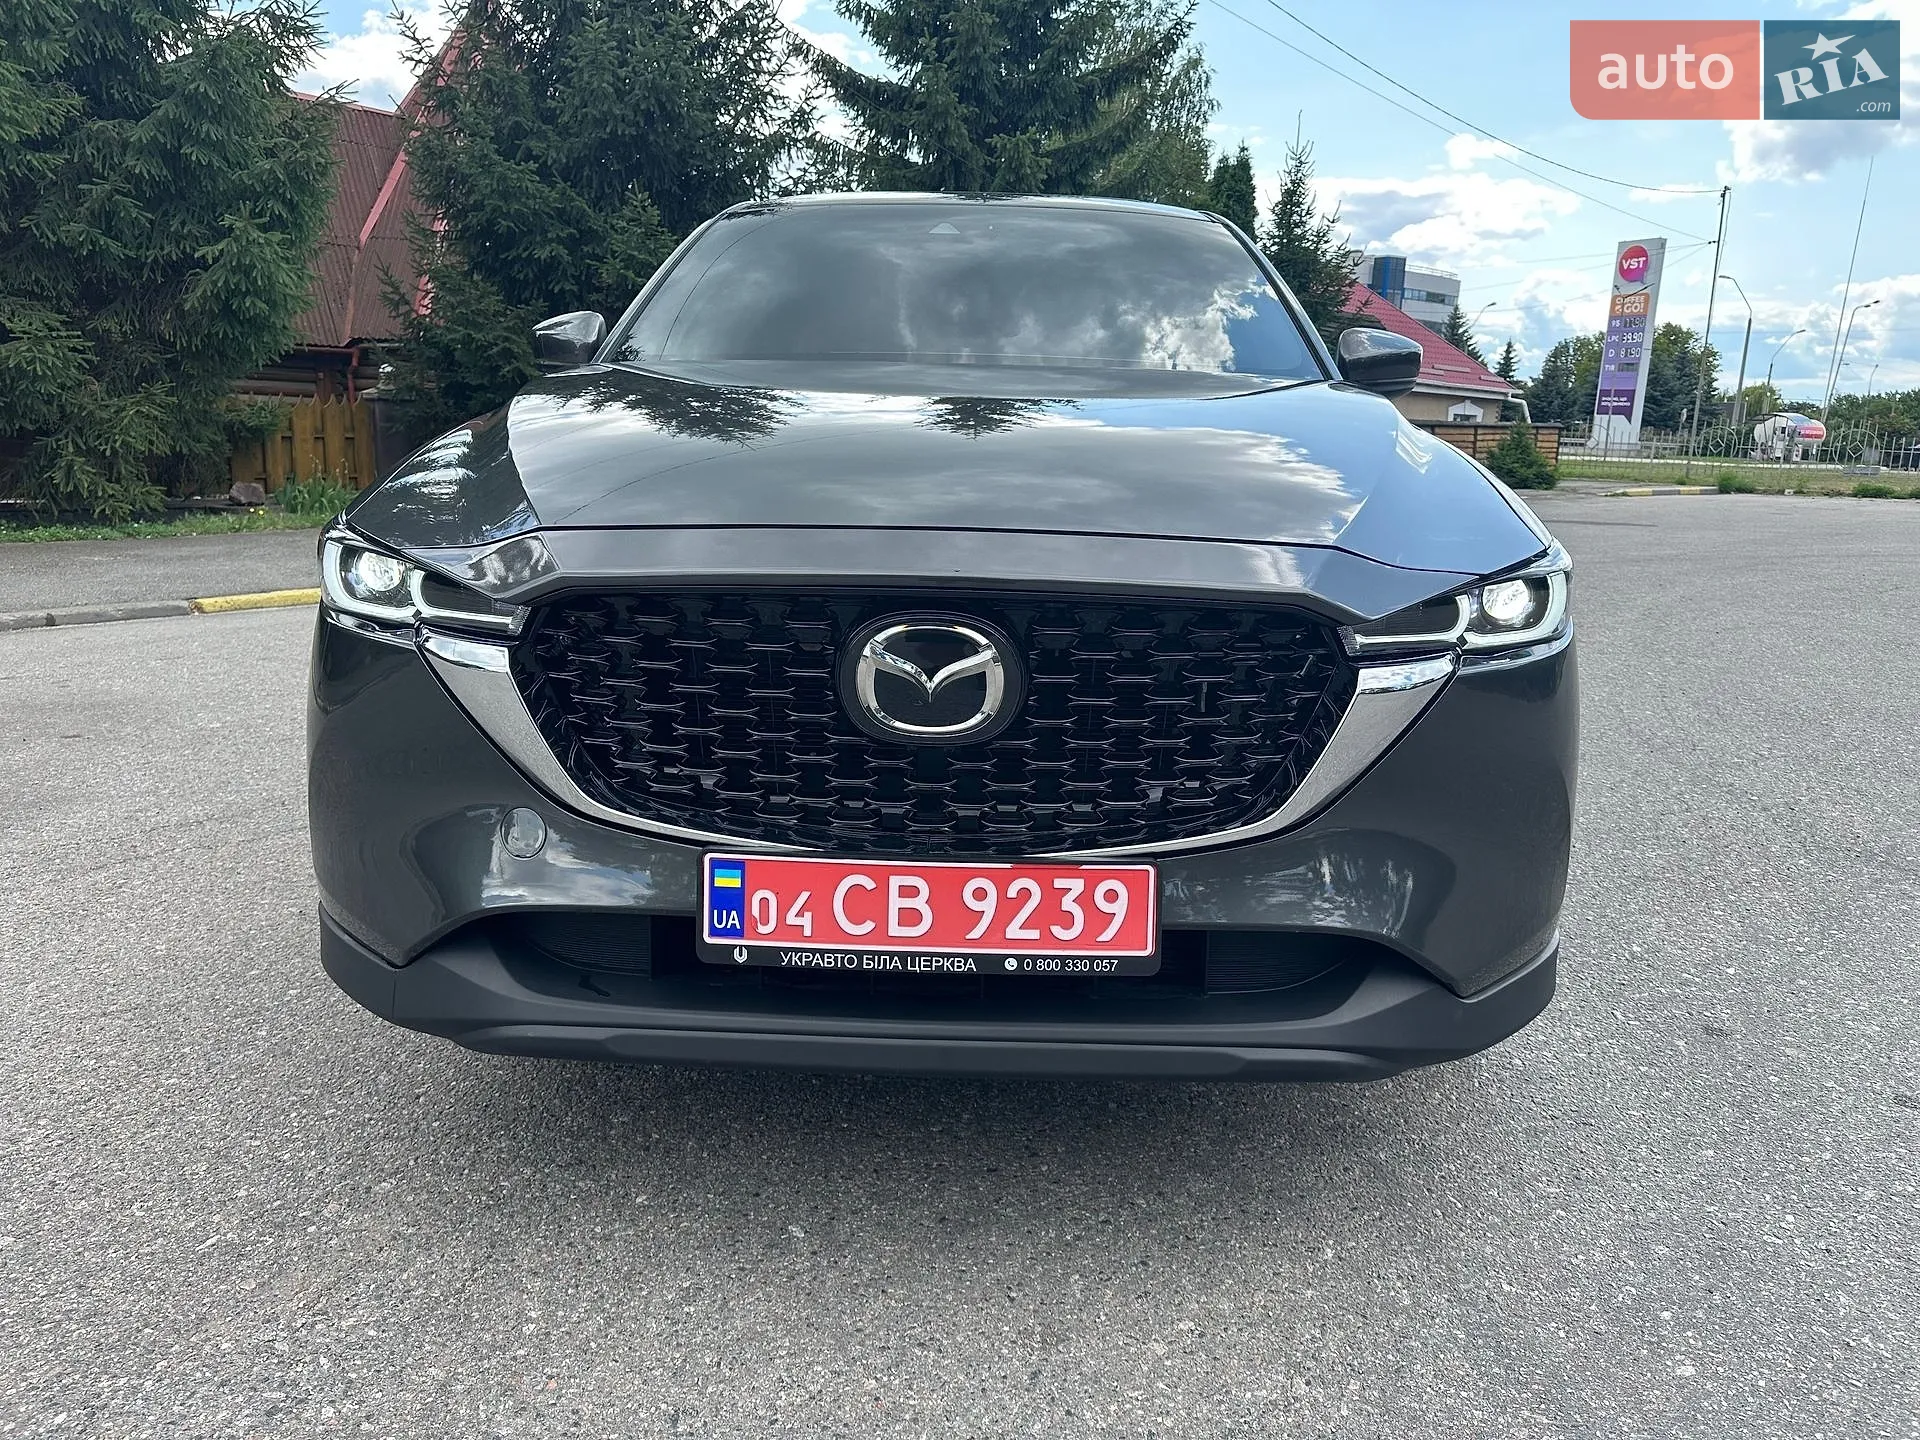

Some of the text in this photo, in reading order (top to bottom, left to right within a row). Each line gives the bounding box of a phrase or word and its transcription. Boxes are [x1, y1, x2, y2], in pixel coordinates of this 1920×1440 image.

[1622, 257, 1647, 270] VST
[1624, 303, 1645, 313] GO!
[1608, 349, 1615, 358] D
[751, 888, 814, 937] 04
[962, 877, 1129, 942] 9239
[713, 910, 741, 929] UA
[779, 951, 977, 973] УКРАВТО БІЛА ЦЕРКВА
[1023, 959, 1119, 972] 0 800 330 057
